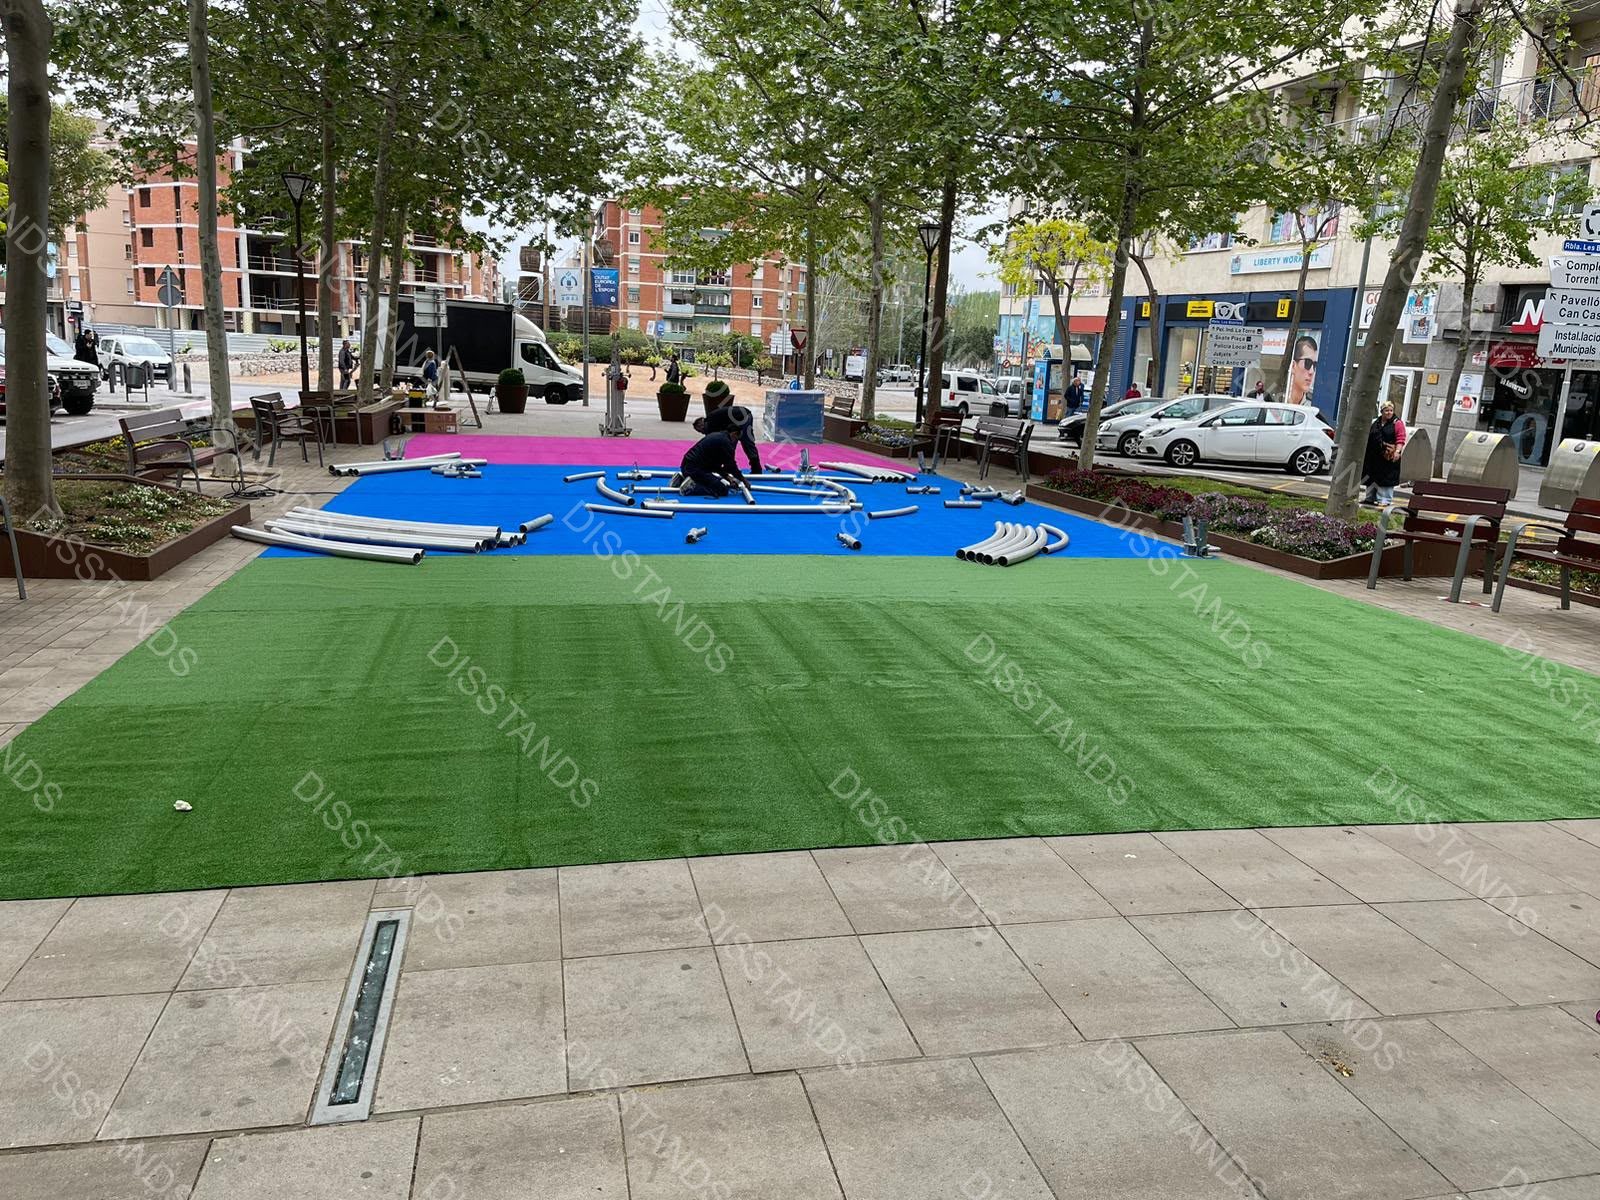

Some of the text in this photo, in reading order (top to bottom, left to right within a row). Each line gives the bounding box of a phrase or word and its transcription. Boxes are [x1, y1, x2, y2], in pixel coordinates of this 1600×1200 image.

[1565, 242, 1583, 251] Rbla.
[1583, 243, 1596, 252] Les
[1254, 257, 1281, 266] LIBERTY
[1565, 273, 1599, 285] Torrent
[1561, 294, 1600, 307] Pavelló
[1559, 308, 1579, 319] Can
[1553, 343, 1596, 355] Municipals
